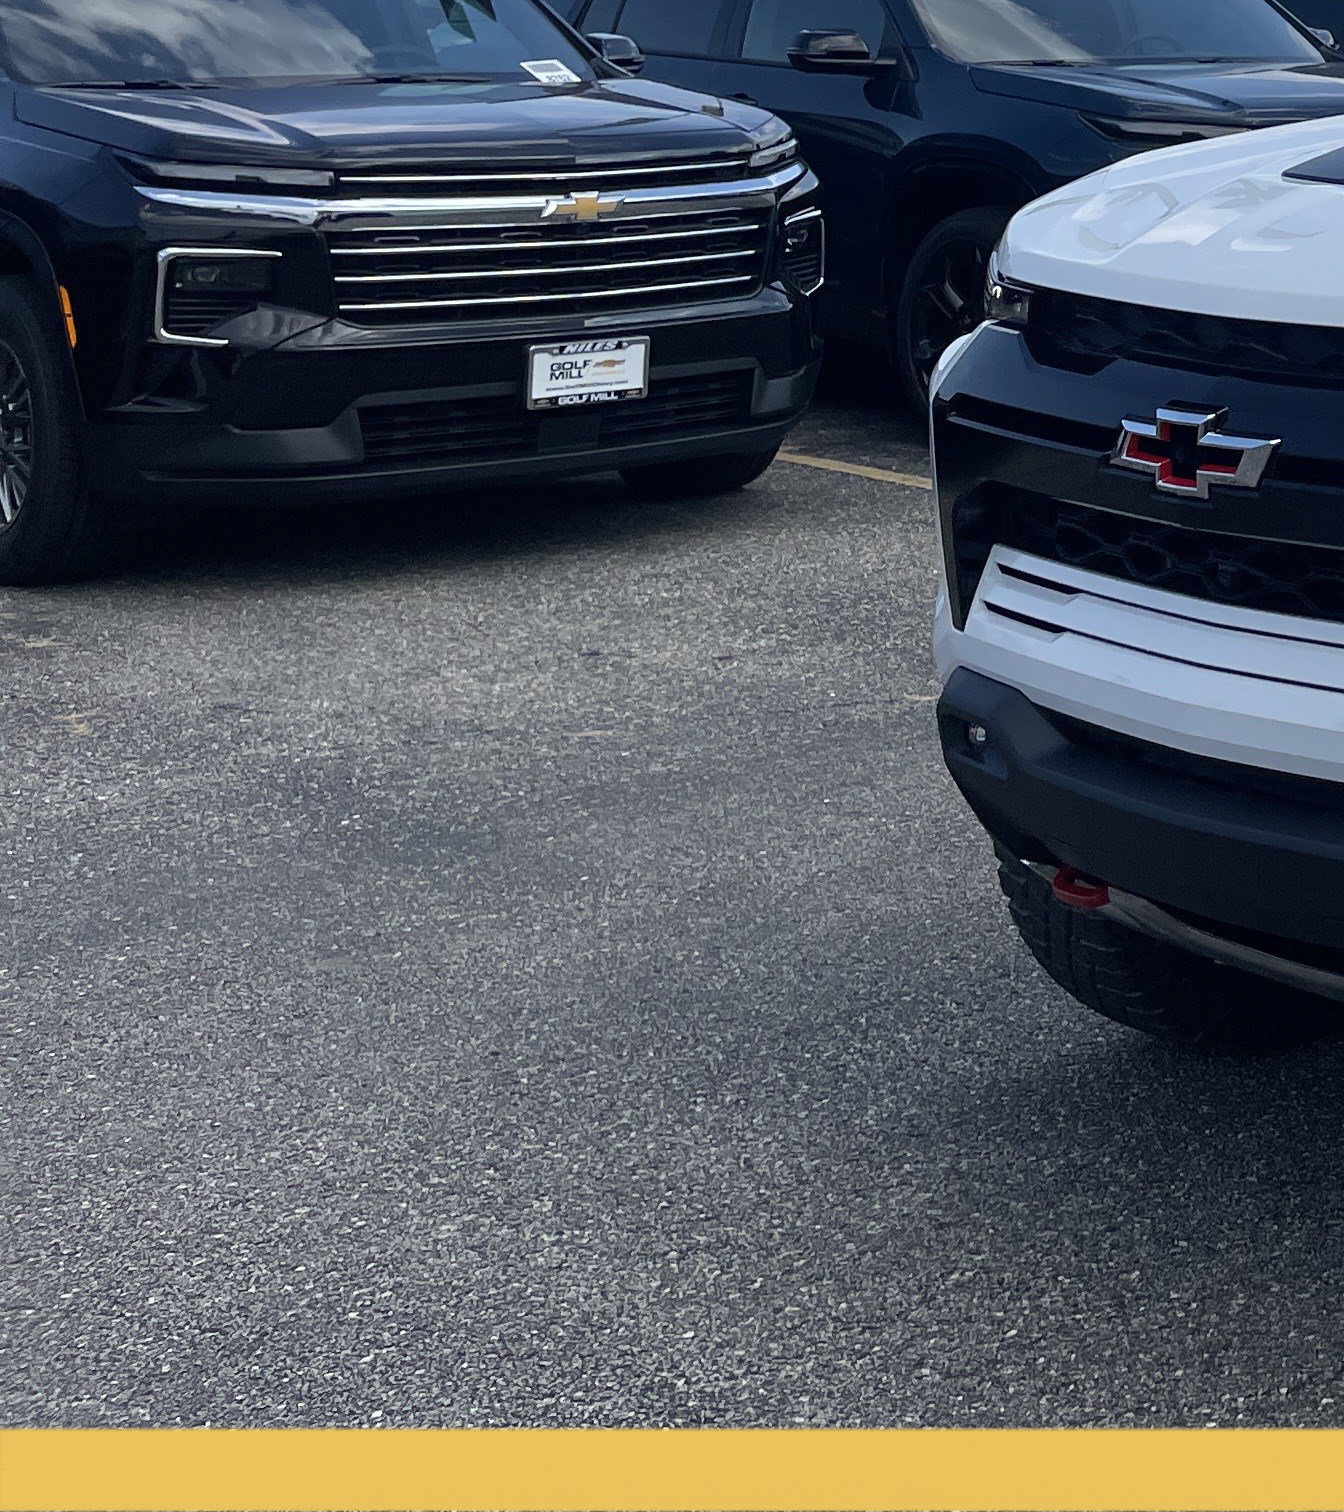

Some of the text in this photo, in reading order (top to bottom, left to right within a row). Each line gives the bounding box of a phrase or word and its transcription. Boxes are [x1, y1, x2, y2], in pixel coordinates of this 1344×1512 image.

[550, 359, 592, 372] GOLF
[550, 370, 583, 381] MILL
[558, 391, 618, 405] GOLF MILL
